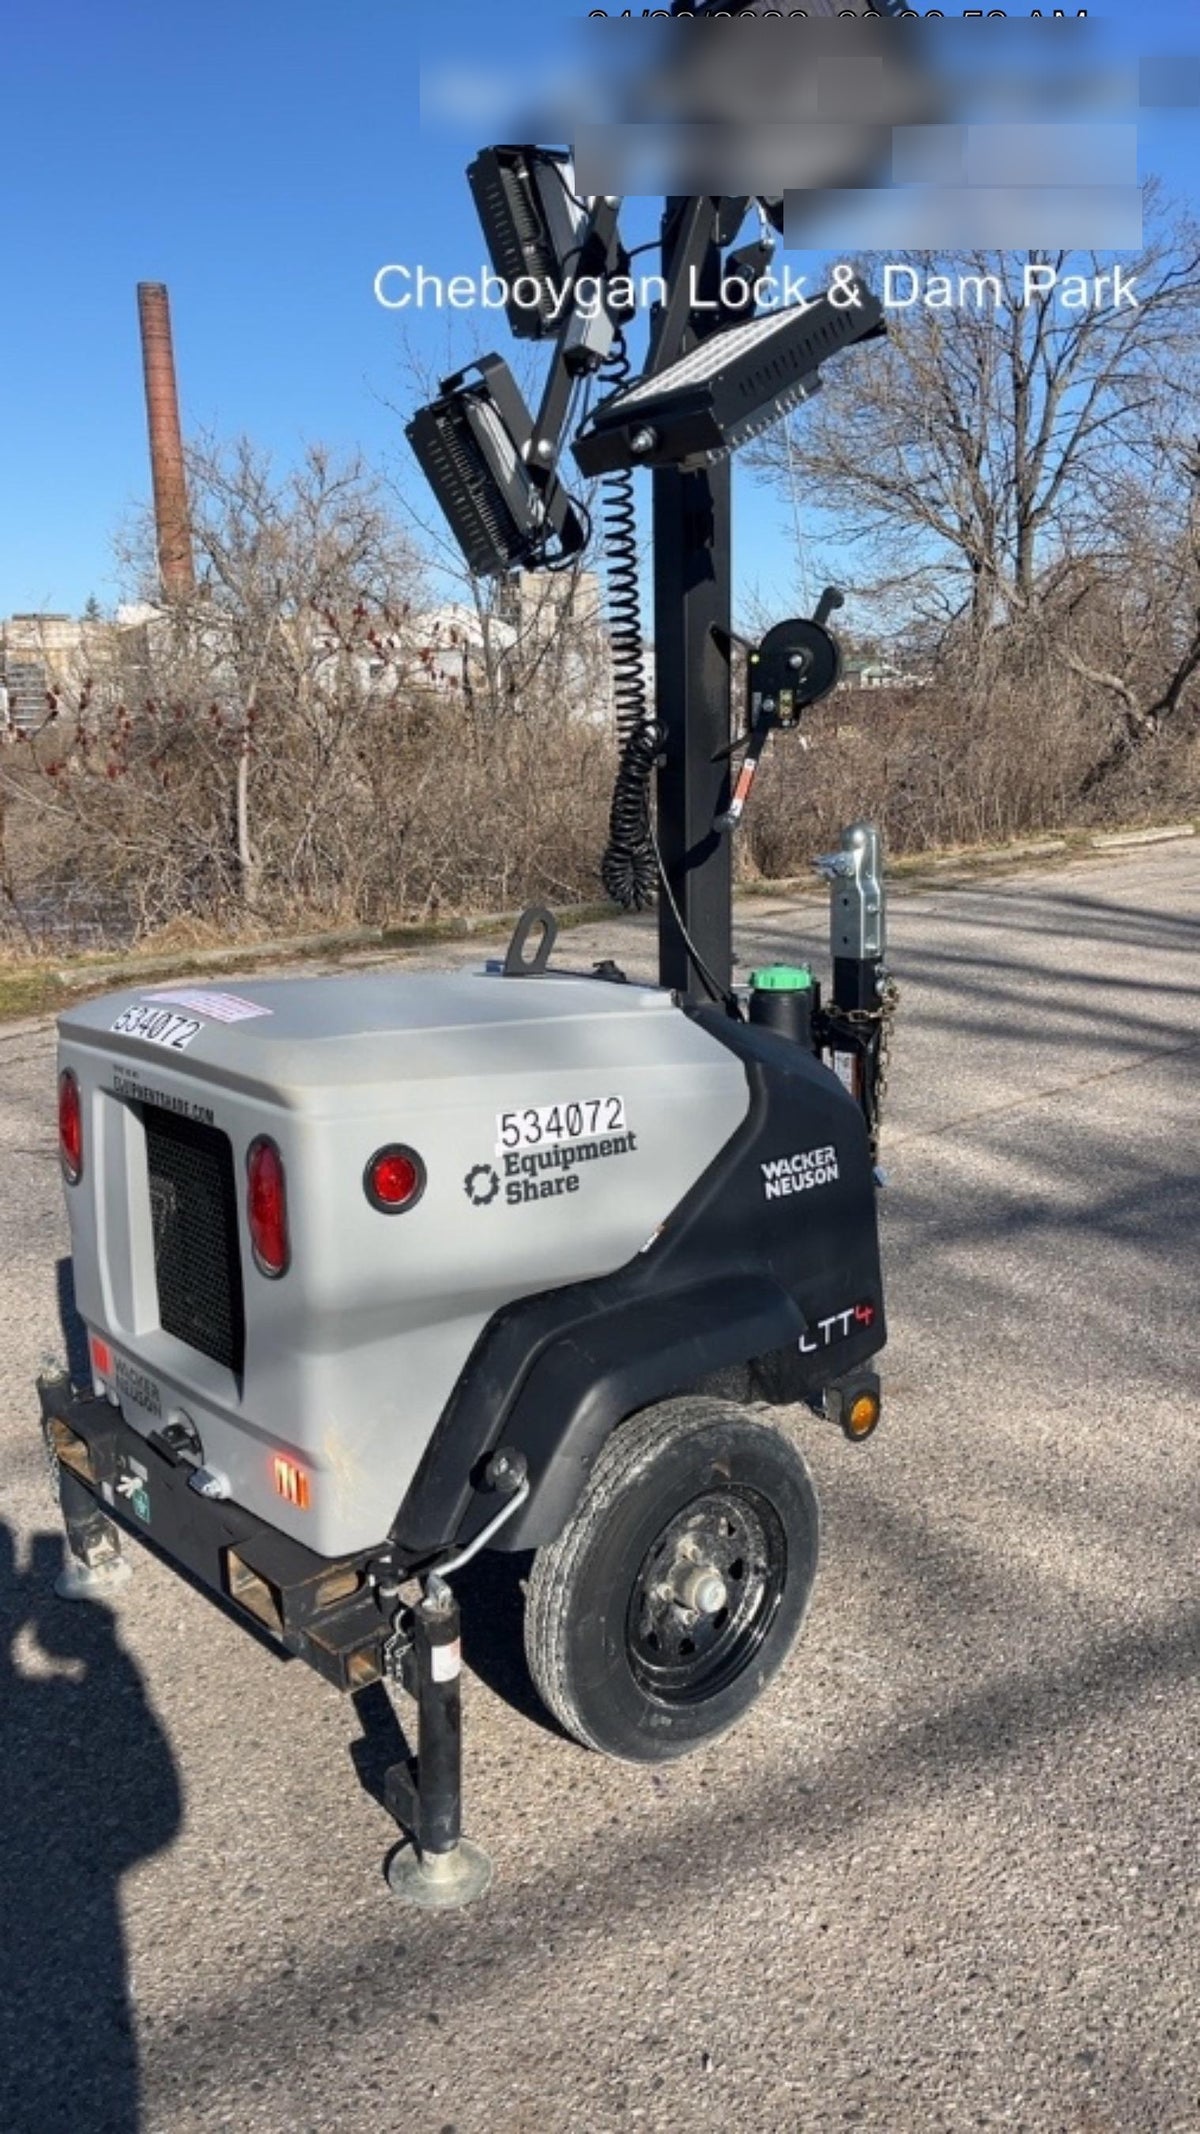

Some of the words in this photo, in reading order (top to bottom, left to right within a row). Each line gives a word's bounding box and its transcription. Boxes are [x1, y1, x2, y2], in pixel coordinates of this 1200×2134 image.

[114, 1006, 201, 1049] 534072
[501, 1096, 624, 1148] 534072
[502, 1130, 638, 1177] Equipment
[761, 1145, 837, 1180] WACKER
[505, 1173, 580, 1206] Share
[764, 1163, 840, 1200] NEUSON
